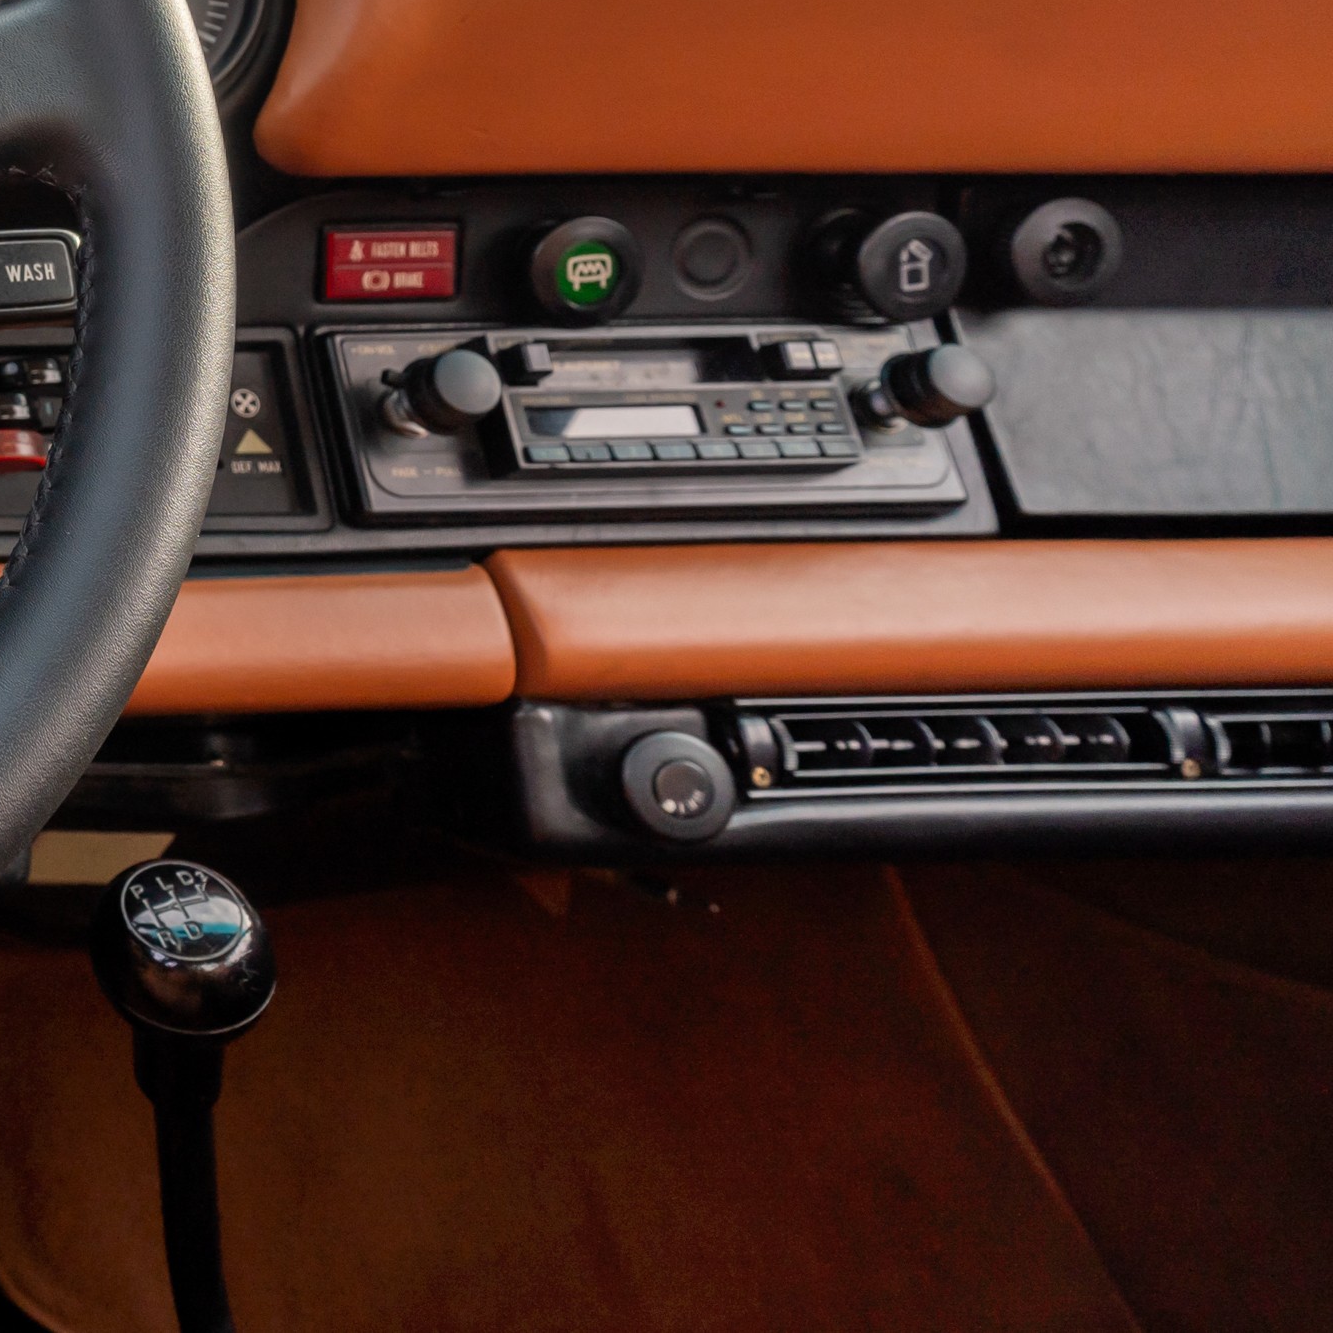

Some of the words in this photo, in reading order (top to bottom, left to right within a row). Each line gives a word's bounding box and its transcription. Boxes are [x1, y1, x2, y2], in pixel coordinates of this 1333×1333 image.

[370, 241, 407, 258] FASTEN
[408, 240, 439, 258] BELTS
[4, 261, 56, 284] WASH
[392, 271, 424, 289] BRAKE
[129, 884, 144, 899] P
[183, 921, 204, 941] D
